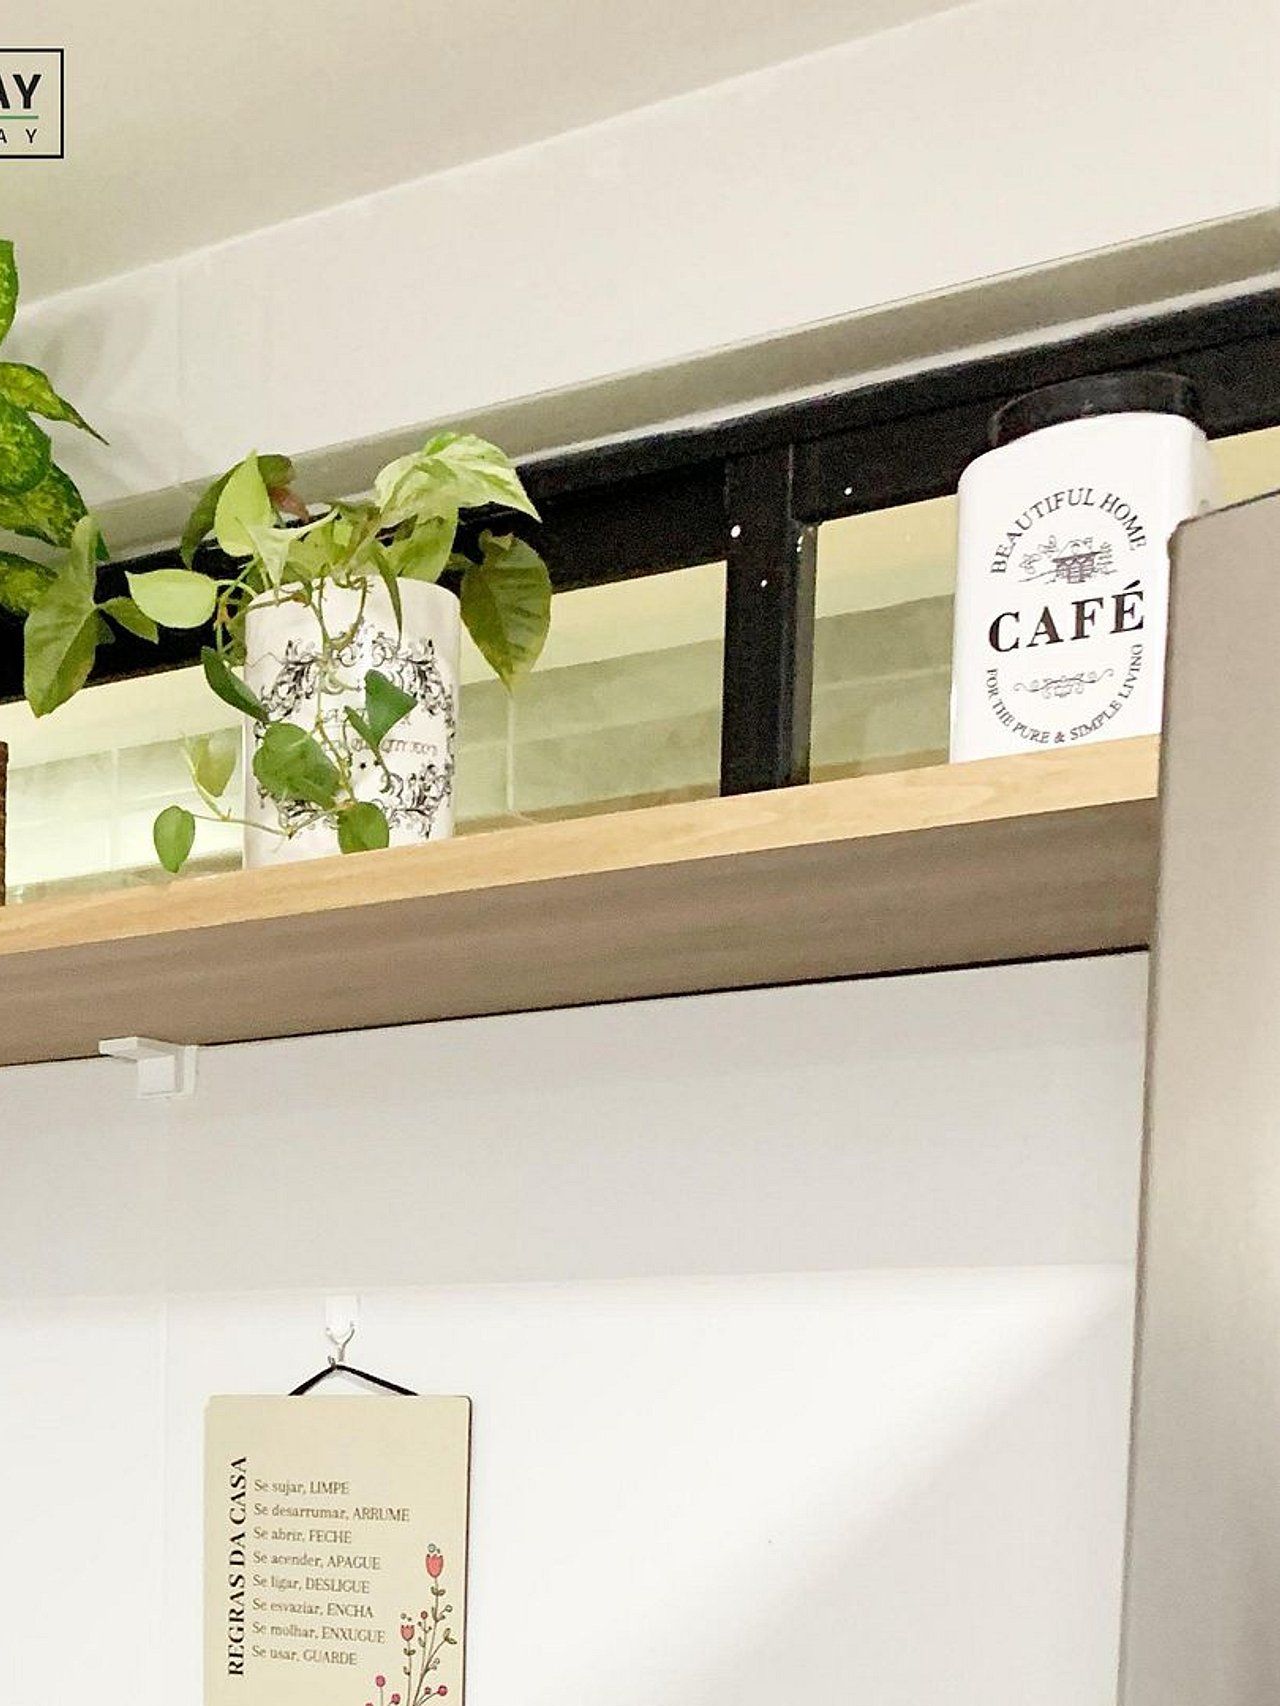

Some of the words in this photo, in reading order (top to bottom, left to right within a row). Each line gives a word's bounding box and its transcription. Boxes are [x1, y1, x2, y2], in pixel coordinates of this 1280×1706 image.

[990, 487, 1094, 573] BEAUTIFUL
[1099, 493, 1147, 551] HOME
[989, 579, 1145, 653] CAFÉ
[1118, 644, 1144, 699] LIVING
[986, 668, 999, 699] FOR
[992, 699, 1016, 727] THE
[1070, 700, 1122, 741] SIMPLE
[1012, 722, 1050, 744] PURE
[1054, 731, 1065, 744] &
[229, 1456, 247, 1525] CASA
[254, 1479, 268, 1492] Se
[272, 1481, 306, 1496] sujar,
[309, 1481, 350, 1495] LIMPE
[254, 1503, 268, 1516] Se
[271, 1504, 349, 1520] desarrumar,
[353, 1507, 410, 1522] ARRUME
[253, 1526, 268, 1539] Se
[271, 1528, 305, 1542] abrir,
[309, 1529, 352, 1544] FECHE
[229, 1532, 246, 1567] DA
[253, 1551, 267, 1564] Se
[270, 1552, 324, 1569] acender,
[327, 1555, 381, 1570] APAGUE
[252, 1574, 267, 1587] Se
[270, 1575, 302, 1592] ligar,
[305, 1577, 370, 1593] DESLIGUE
[252, 1598, 267, 1611] Se
[327, 1602, 374, 1618] ENCHA
[228, 1573, 245, 1676] REGRAS
[252, 1622, 266, 1634] Se
[270, 1624, 319, 1640] molhar,
[322, 1626, 386, 1644] ENXUGUE
[252, 1645, 266, 1658] Se
[270, 1648, 300, 1662] usar,
[303, 1649, 358, 1665] GUARDE
